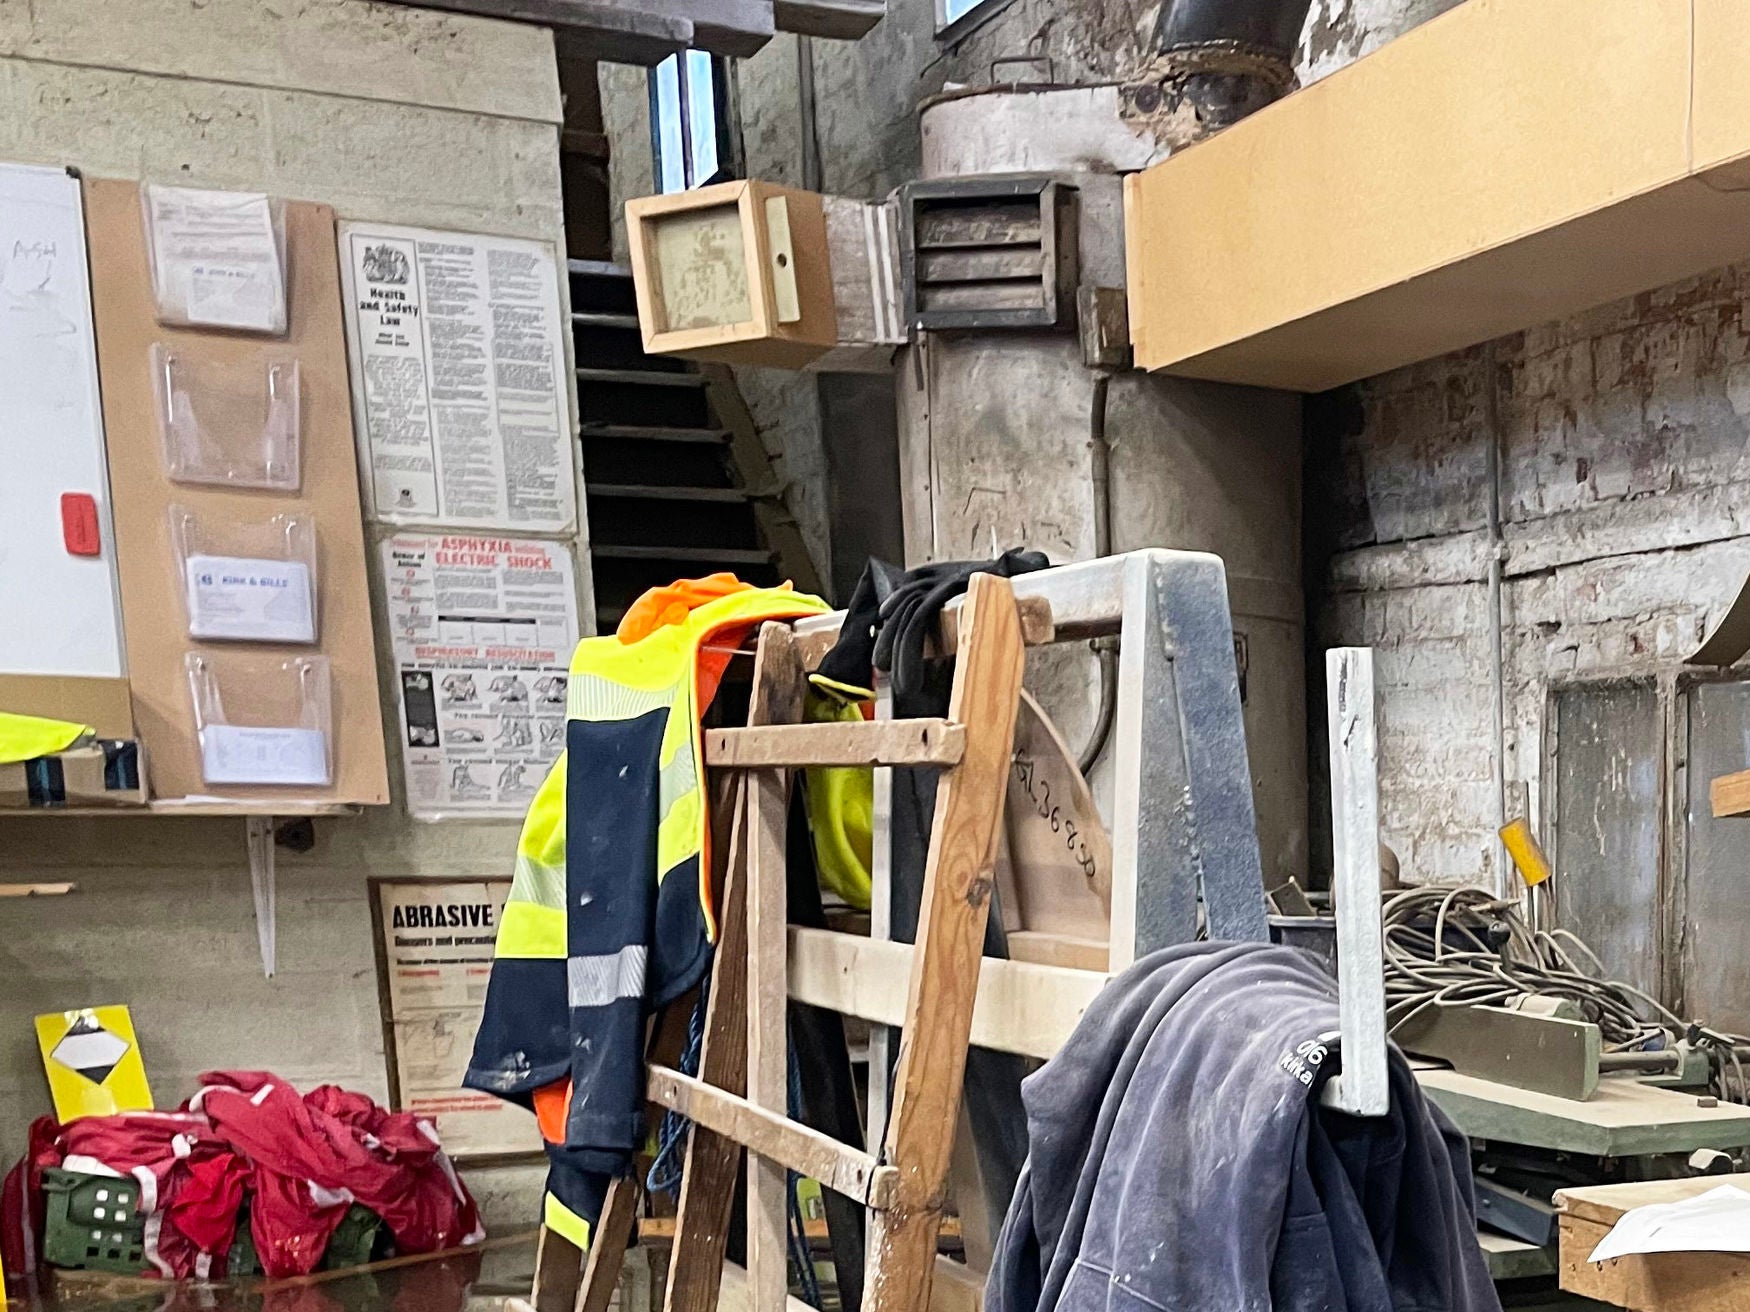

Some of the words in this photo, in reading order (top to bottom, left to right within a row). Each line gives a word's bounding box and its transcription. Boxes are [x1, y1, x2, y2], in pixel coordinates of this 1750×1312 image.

[370, 288, 405, 300] Health
[360, 301, 379, 310] and
[384, 302, 418, 317] Safety
[380, 315, 400, 325] Law
[442, 538, 512, 552] ASPHYXIA
[435, 552, 498, 566] ELECTRIC
[507, 556, 553, 569] SHOCK
[393, 904, 493, 928] ABRASIVE
